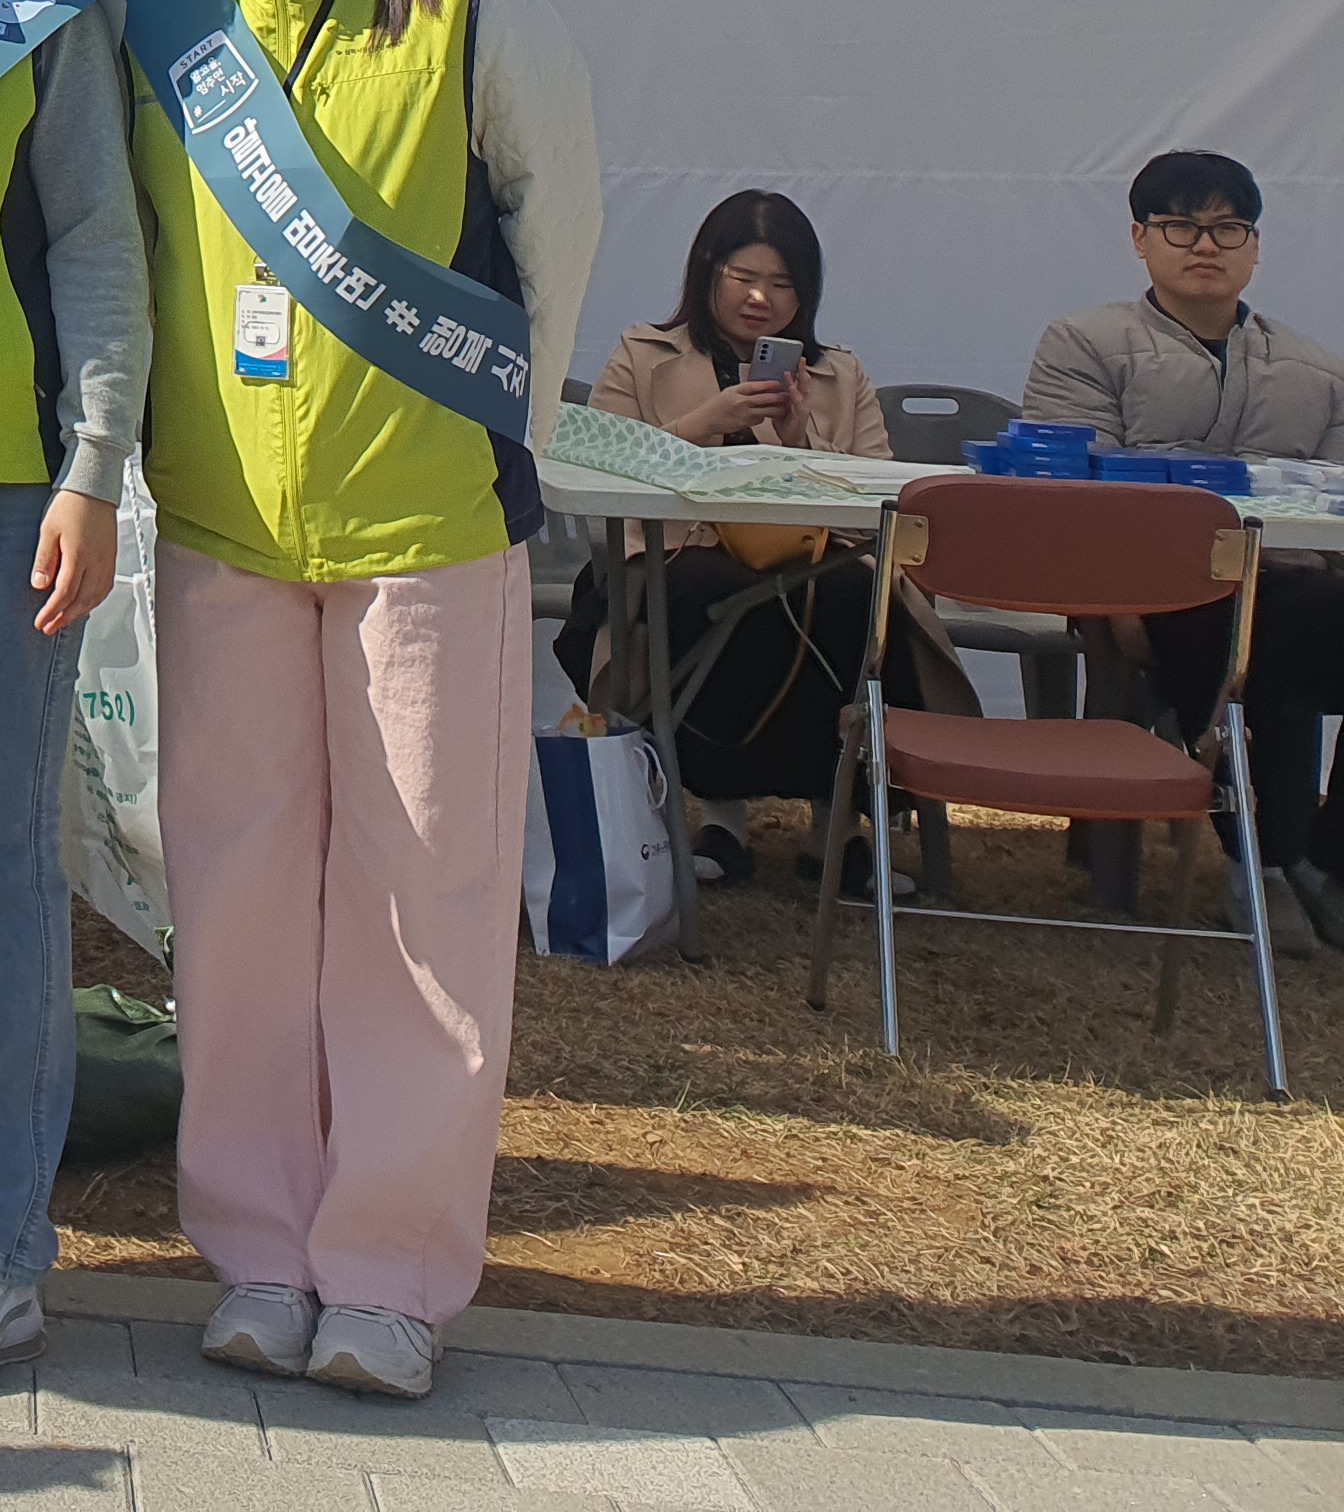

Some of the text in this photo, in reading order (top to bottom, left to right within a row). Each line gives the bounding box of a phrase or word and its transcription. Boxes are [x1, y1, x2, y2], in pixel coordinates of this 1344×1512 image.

[179, 37, 215, 71] START
[219, 72, 247, 97] 시작
[224, 116, 298, 222] 알코올
[283, 210, 387, 311] 멈추면
[419, 315, 493, 374] 행복
